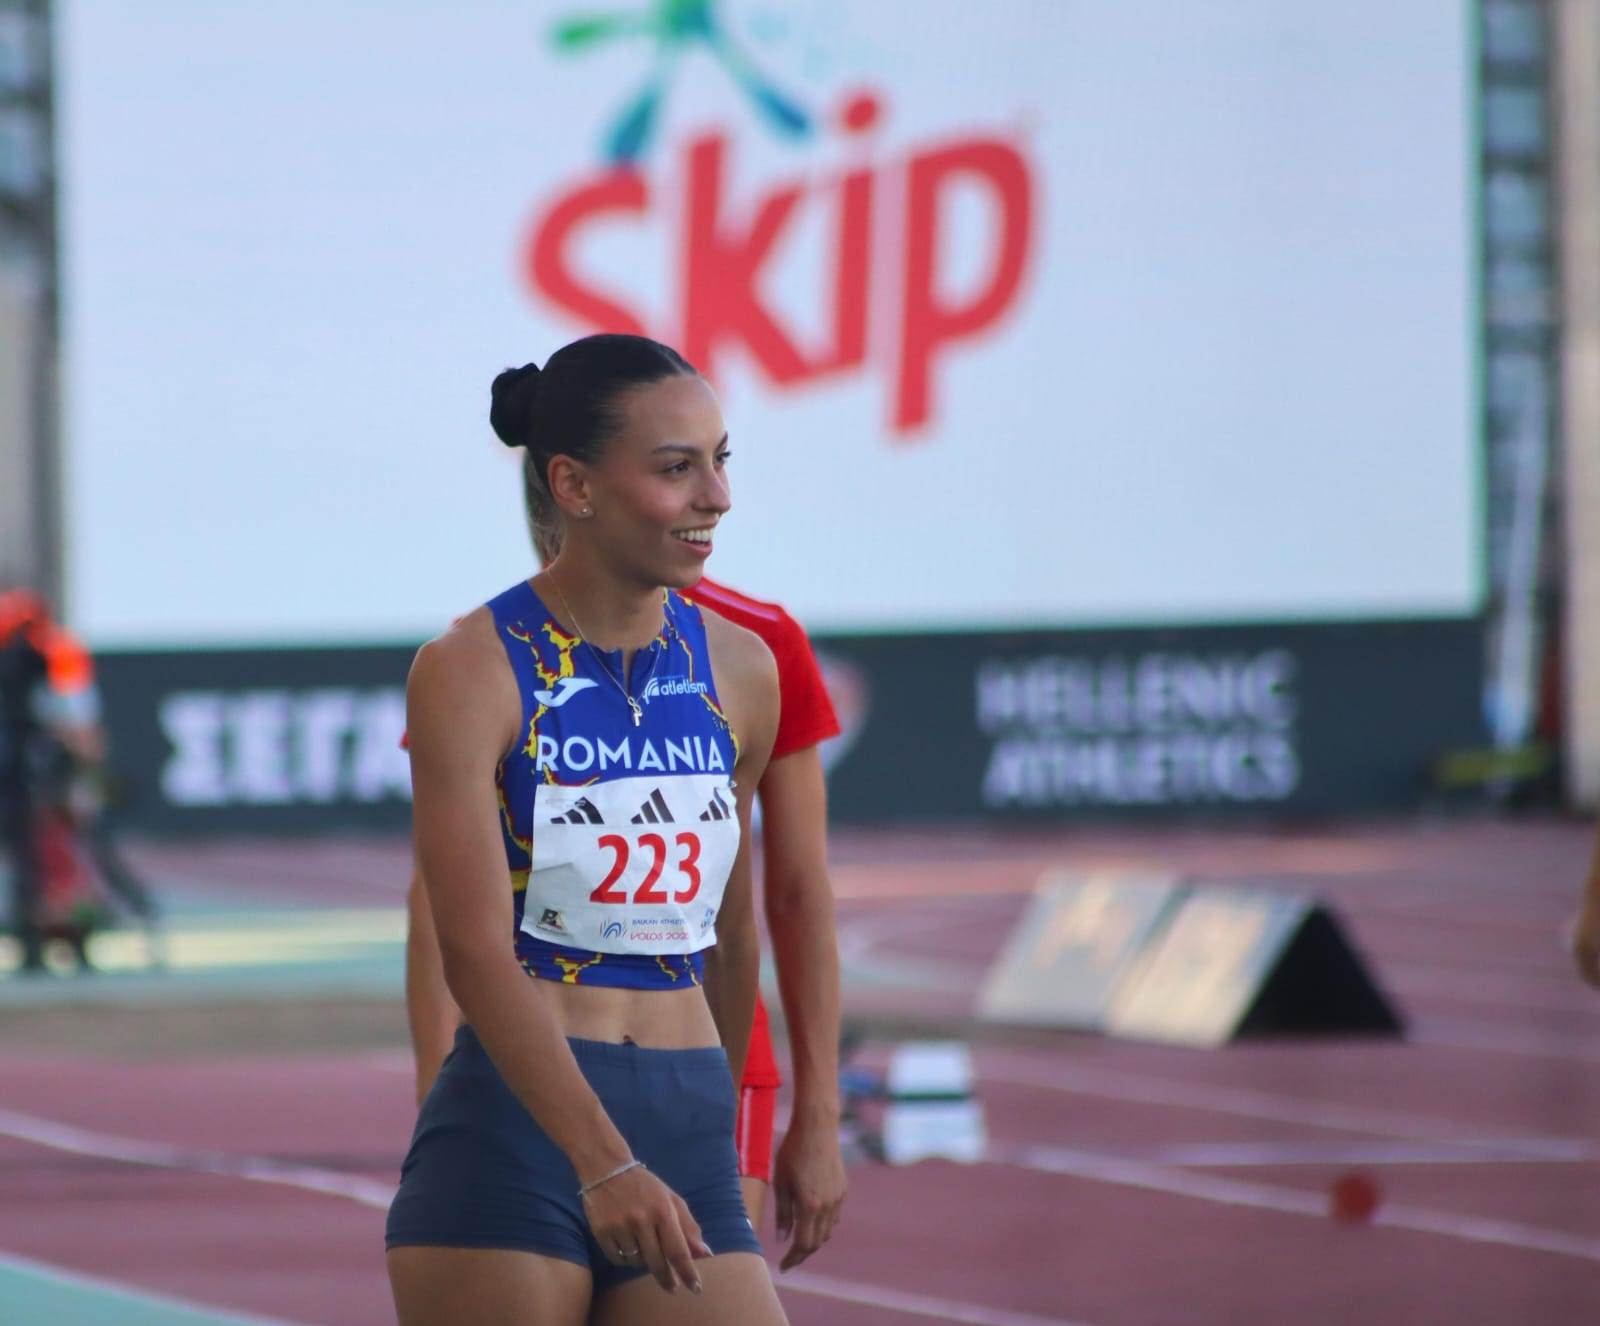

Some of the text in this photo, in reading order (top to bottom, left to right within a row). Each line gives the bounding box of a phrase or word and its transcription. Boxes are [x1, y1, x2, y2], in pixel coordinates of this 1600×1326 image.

[660, 679, 708, 696] atletism
[976, 651, 1297, 734] HELLENIC
[535, 735, 726, 772] ROMANIA
[983, 735, 1300, 804] ATHLETICS
[589, 831, 702, 904] 223
